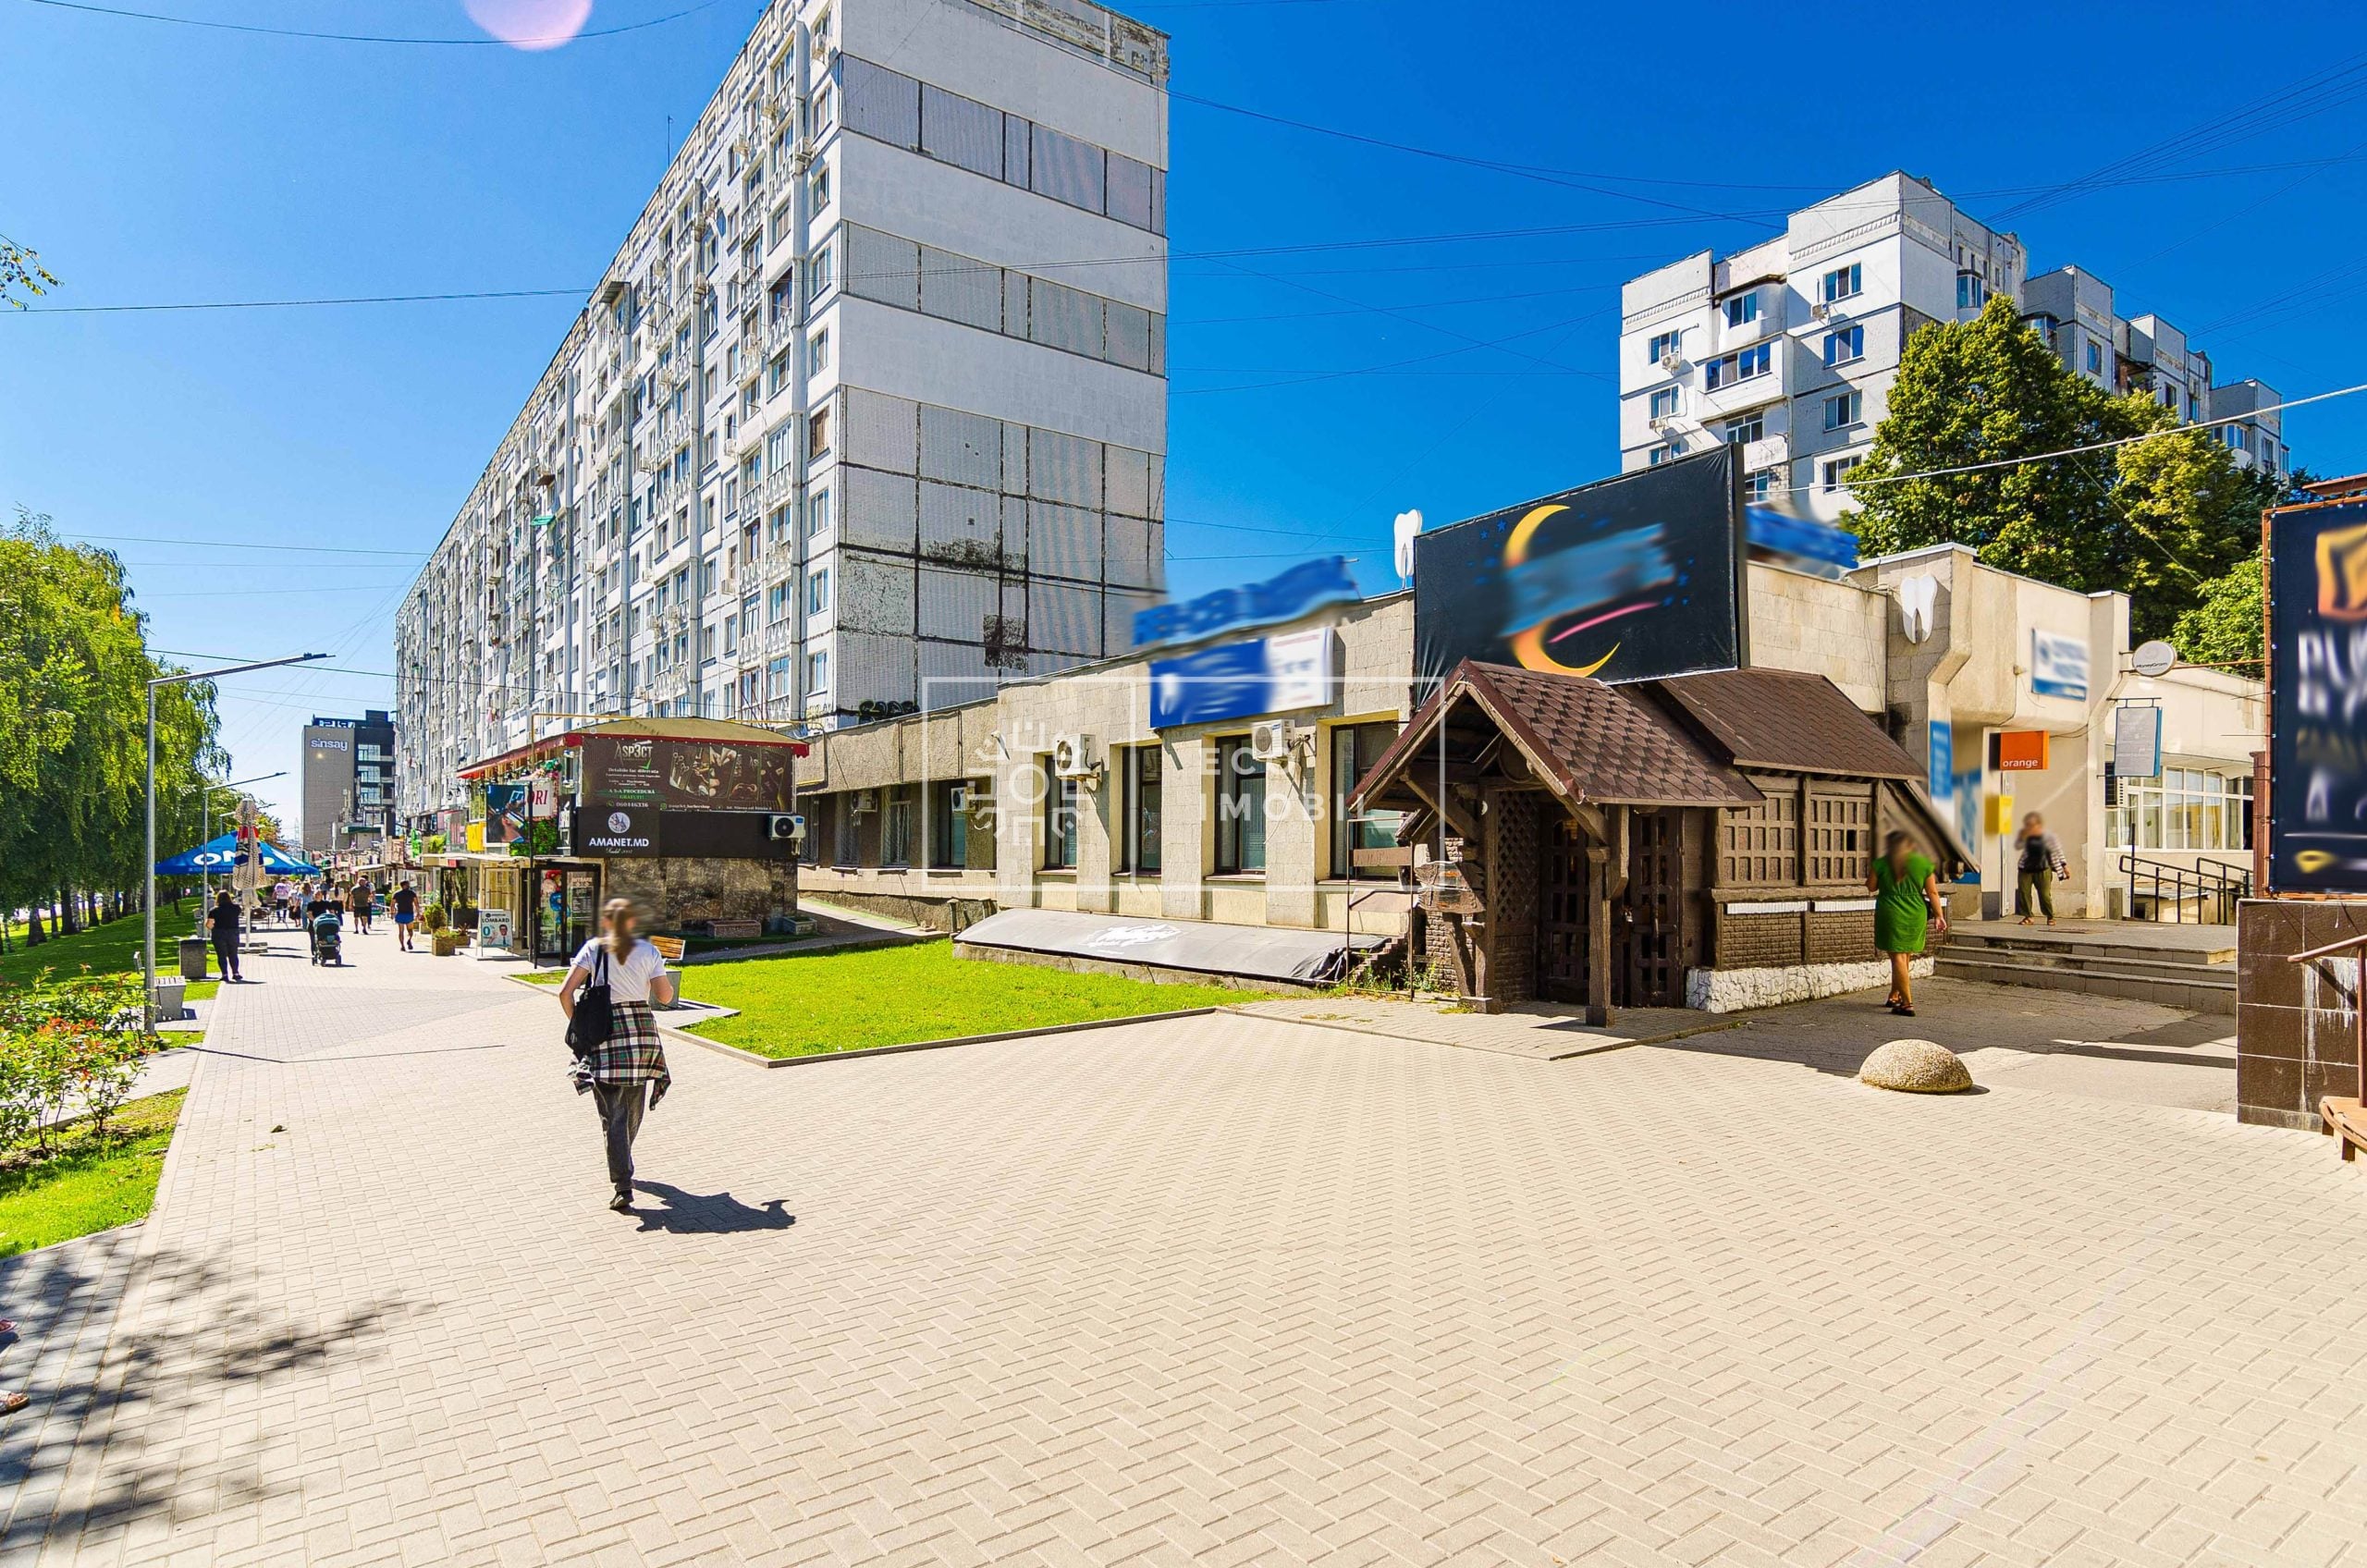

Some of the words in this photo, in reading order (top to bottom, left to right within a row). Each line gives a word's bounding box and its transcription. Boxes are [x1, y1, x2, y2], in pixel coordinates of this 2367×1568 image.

[311, 739, 348, 751] sinsay
[2002, 759, 2039, 769] orange
[588, 837, 649, 847] AMANET.MD
